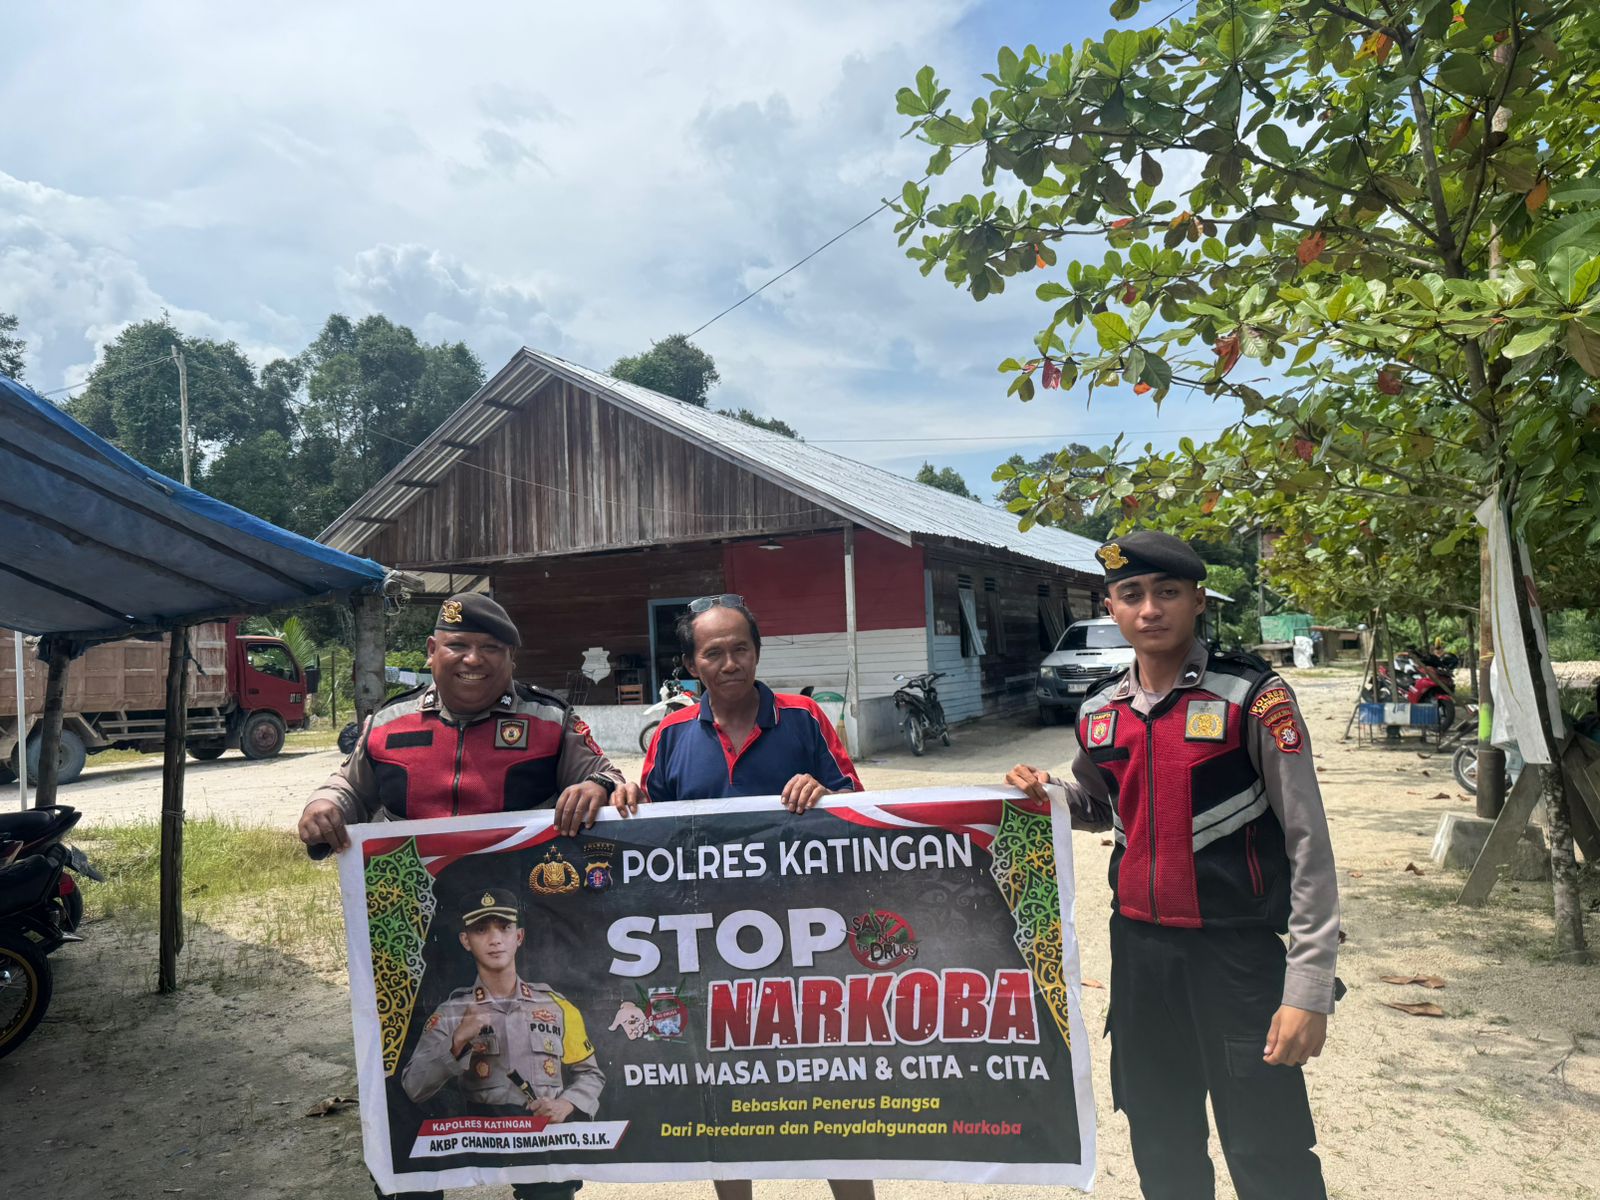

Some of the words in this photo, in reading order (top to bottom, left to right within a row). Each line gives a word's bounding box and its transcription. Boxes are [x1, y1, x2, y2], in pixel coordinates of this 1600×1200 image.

[622, 842, 767, 884] POLRES
[779, 832, 973, 876] KATINGAN
[852, 913, 890, 932] SAY
[606, 907, 848, 978] STOP
[870, 943, 918, 961] DRUGS
[706, 968, 1041, 1051] NARKOBA
[530, 1022, 561, 1036] POLRI
[624, 1063, 689, 1086] DEMI
[695, 1060, 770, 1086] MASA
[776, 1057, 867, 1084] DEPAN
[875, 1056, 893, 1081] &
[900, 1055, 963, 1080] CITA
[970, 1064, 979, 1073] -
[986, 1055, 1050, 1081] CITA
[731, 1097, 808, 1113] Bebaskan
[812, 1096, 876, 1111] Penerus
[880, 1095, 940, 1112] Bangsa
[432, 1120, 482, 1132] KAPOLRES
[484, 1119, 532, 1130] KATINGAN
[661, 1122, 693, 1137] Dari
[696, 1122, 775, 1137] Peredaran
[779, 1121, 809, 1135] dan
[813, 1119, 948, 1137] Penyalahgunaan
[952, 1119, 1022, 1136] Narkoba
[429, 1137, 458, 1152] AKBP
[461, 1135, 510, 1149] CHANDRA
[513, 1133, 581, 1148] ISMAWANTO,
[582, 1132, 610, 1146] S.I.K.
